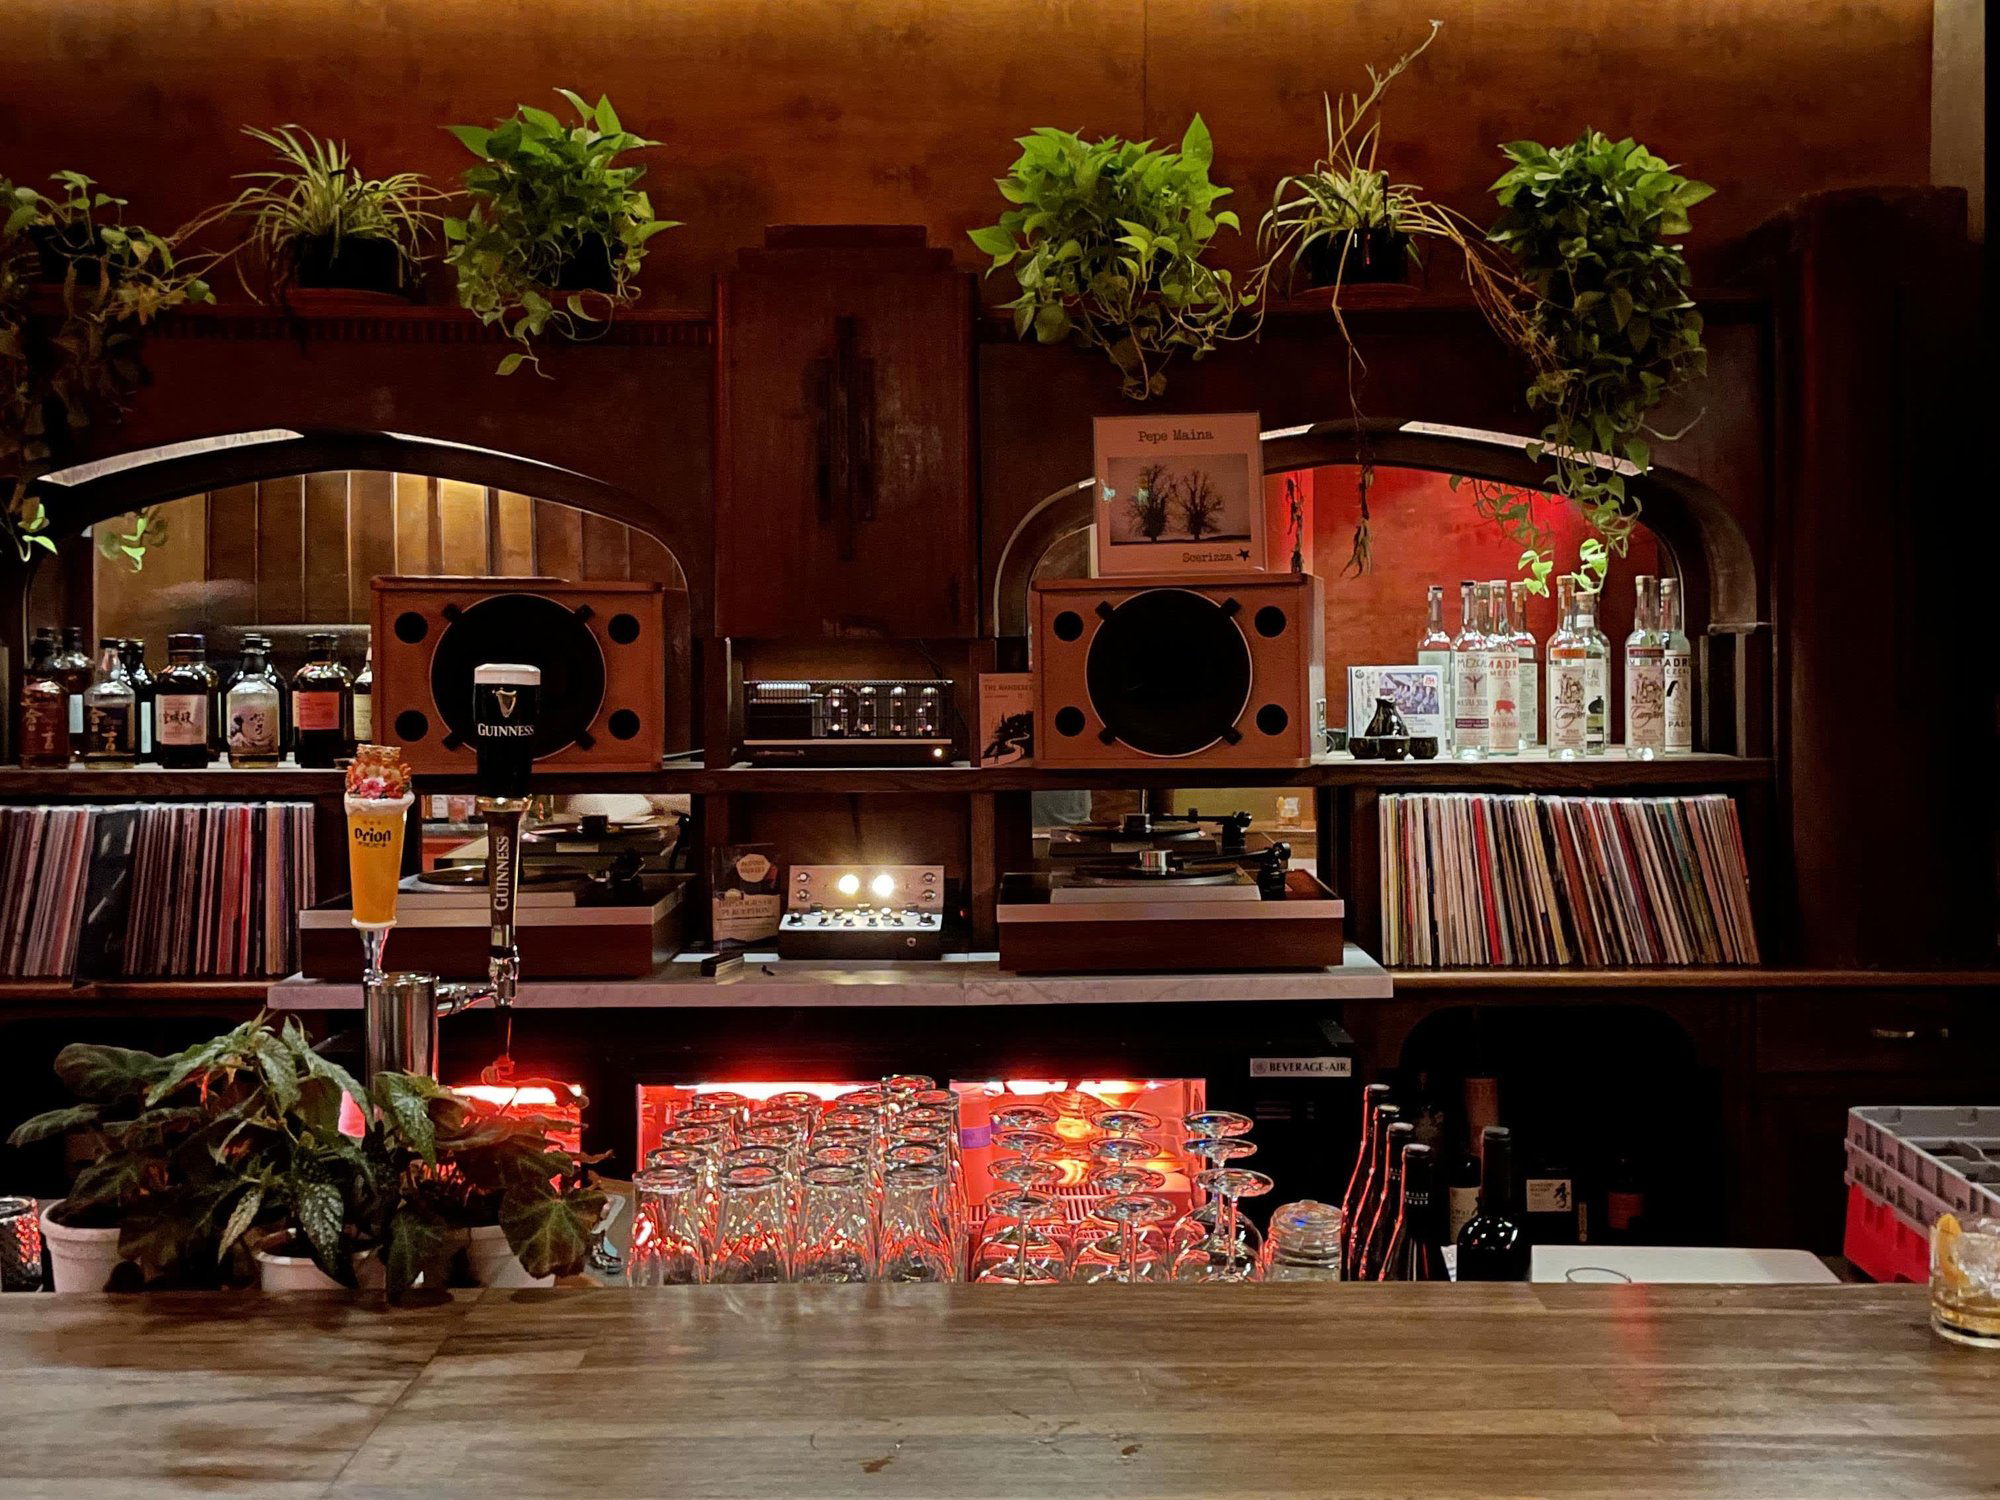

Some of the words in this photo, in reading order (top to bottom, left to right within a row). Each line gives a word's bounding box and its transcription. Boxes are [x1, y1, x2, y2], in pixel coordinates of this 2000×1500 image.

[1138, 431, 1168, 444] Pepe
[1173, 430, 1214, 441] Maina
[477, 722, 535, 737] GUINNESS
[354, 827, 392, 843] Orion
[494, 835, 510, 911] GUINNESS
[1269, 1062, 1347, 1073] BEVERAGE-AIR
